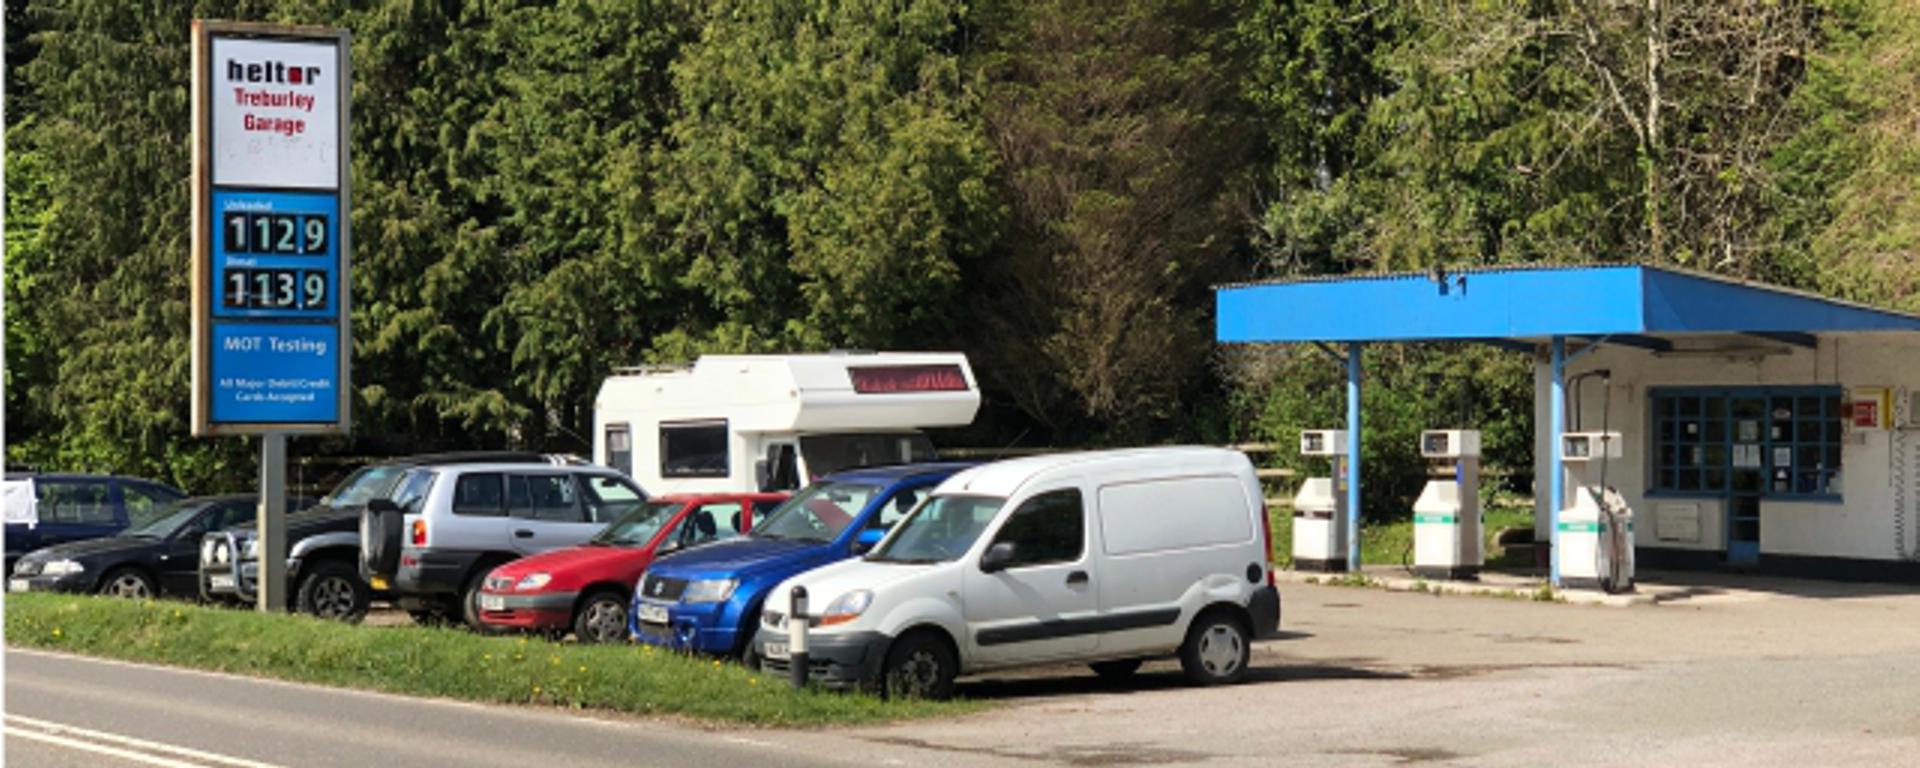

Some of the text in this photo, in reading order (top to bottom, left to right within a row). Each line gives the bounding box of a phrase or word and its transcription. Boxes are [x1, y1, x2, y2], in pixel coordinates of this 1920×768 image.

[234, 87, 315, 112] Treburley
[243, 114, 305, 137] Garage
[230, 216, 325, 253] 112.9
[229, 273, 325, 311] 113.9
[223, 336, 327, 356] MOT Testing
